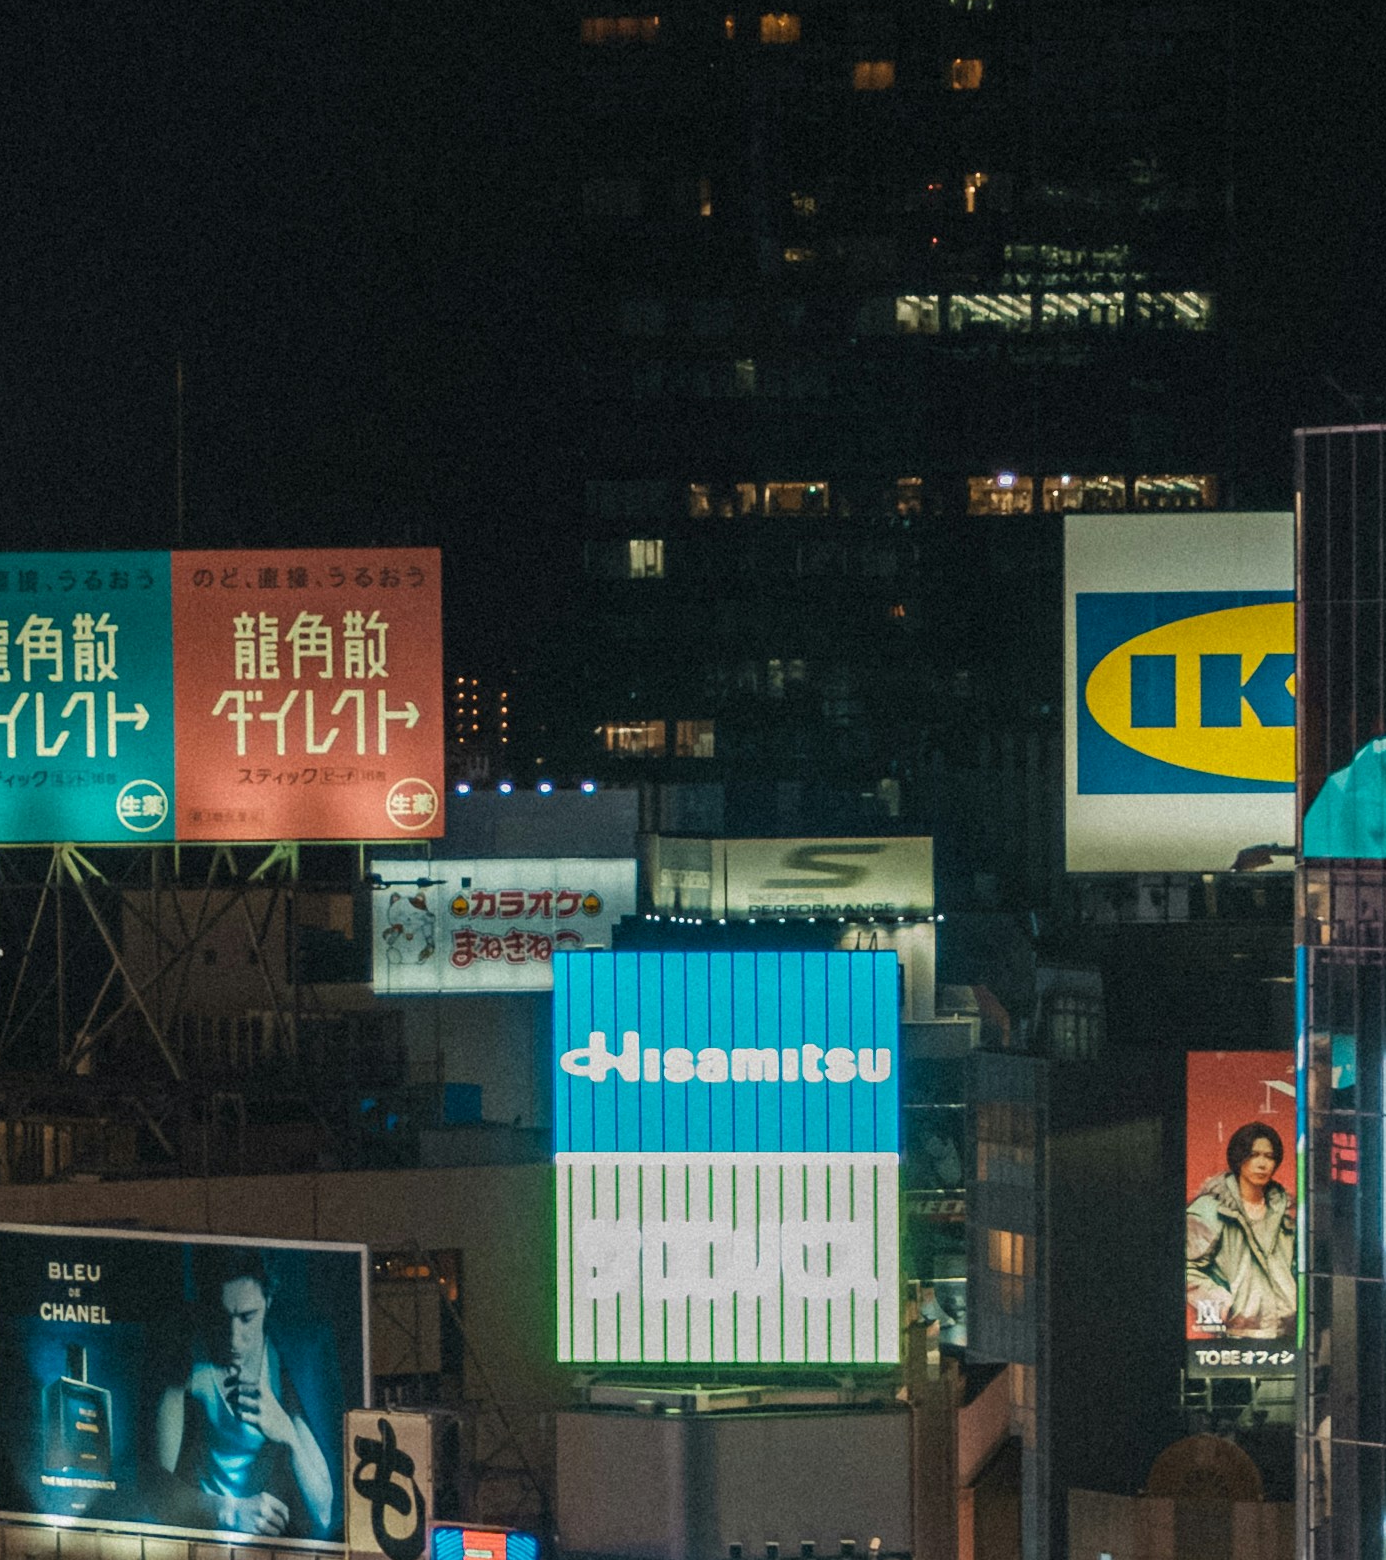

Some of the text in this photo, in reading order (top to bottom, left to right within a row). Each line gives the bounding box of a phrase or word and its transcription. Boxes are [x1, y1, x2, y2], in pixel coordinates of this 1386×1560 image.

[232, 609, 390, 681] 龍角散
[211, 689, 421, 756] ダイレクト
[121, 793, 165, 817] 生薬
[391, 792, 434, 816] 生薬
[470, 888, 581, 918] カラオケ
[749, 903, 895, 915] PERFORMANCE
[560, 1030, 891, 1083] Hisamitsu
[48, 1262, 101, 1282] BLEU
[68, 1288, 81, 1298] DE
[40, 1303, 110, 1325] CHANEL
